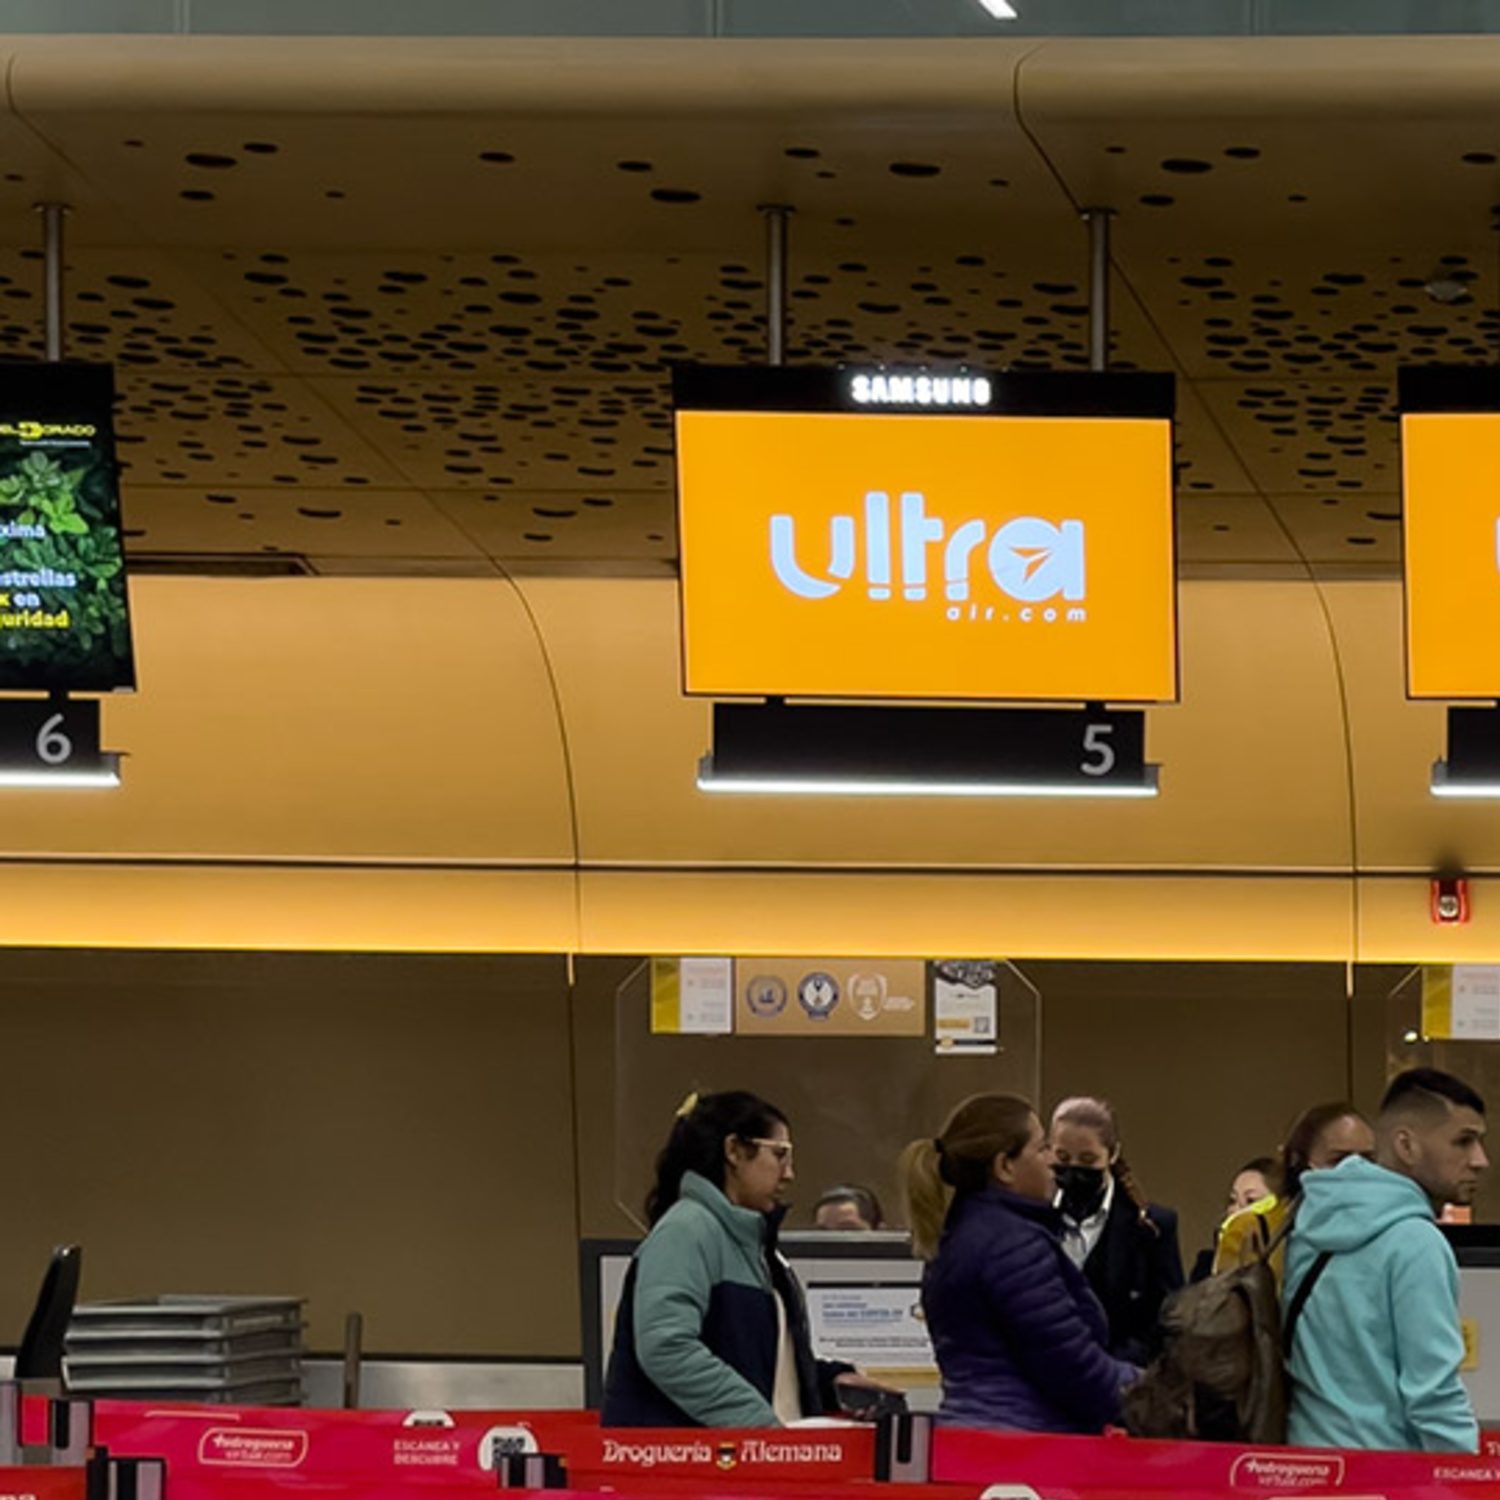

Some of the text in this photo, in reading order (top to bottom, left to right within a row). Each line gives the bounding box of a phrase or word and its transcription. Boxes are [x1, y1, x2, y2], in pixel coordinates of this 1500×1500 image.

[851, 375, 991, 406] SAMSUNG
[769, 491, 1087, 601] ultra
[946, 603, 1088, 622] air.com
[36, 713, 73, 763] 6
[1080, 724, 1115, 776] 5
[393, 1439, 449, 1452] ESCANEA
[741, 1440, 843, 1463] Alemana
[393, 1453, 459, 1466] DESCUBRE
